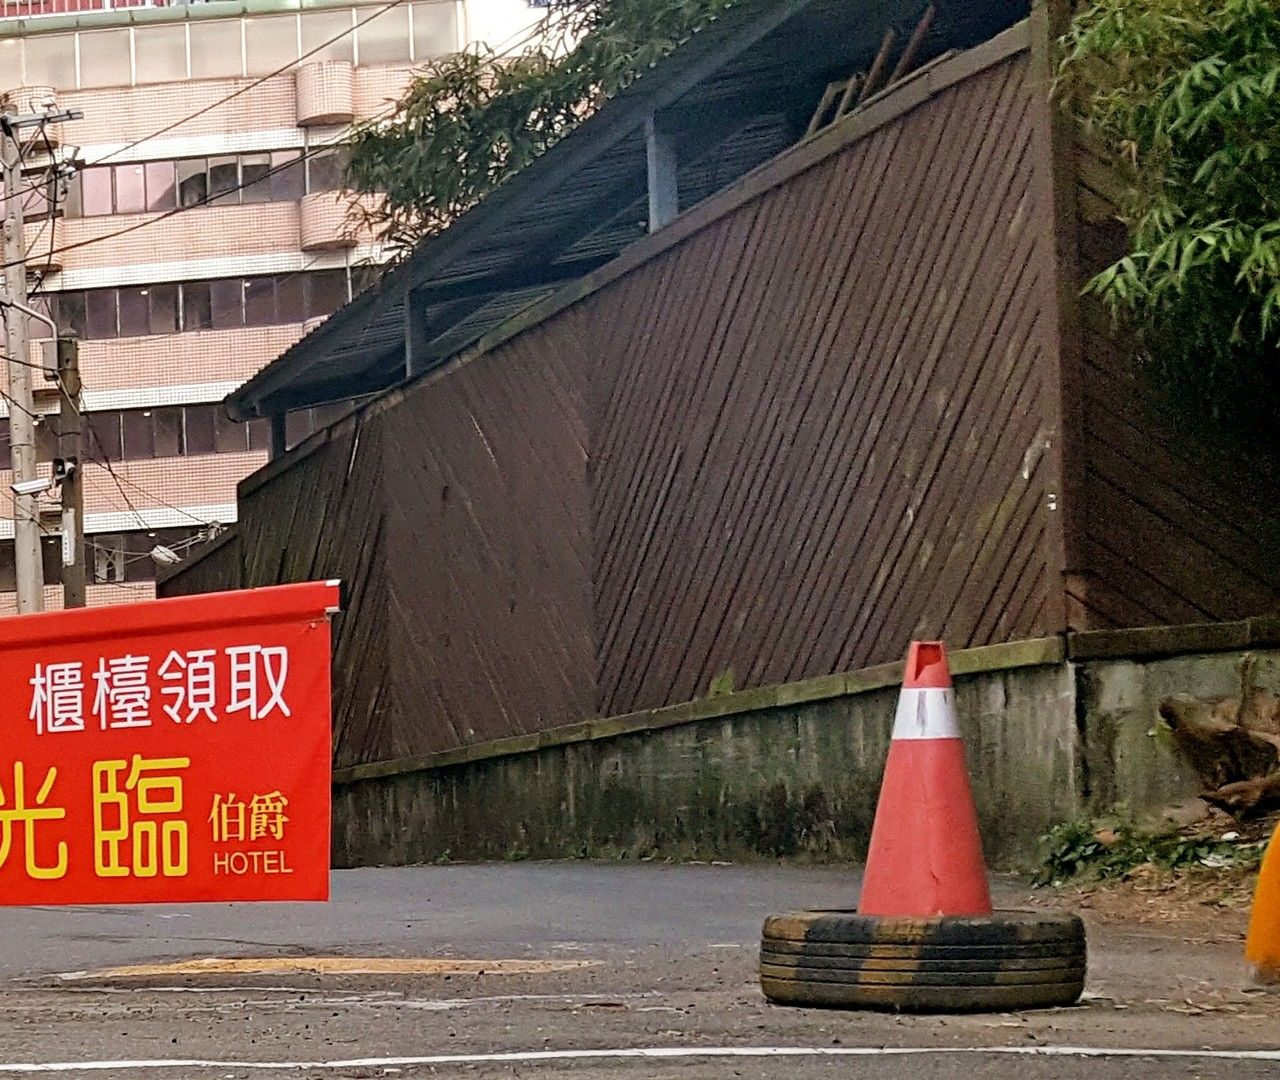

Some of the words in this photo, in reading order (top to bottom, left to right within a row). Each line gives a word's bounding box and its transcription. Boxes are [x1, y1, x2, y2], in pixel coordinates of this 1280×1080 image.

[28, 644, 291, 735] 櫃檯領取
[207, 790, 289, 842] 伯爵
[214, 850, 293, 875] HOTEL
